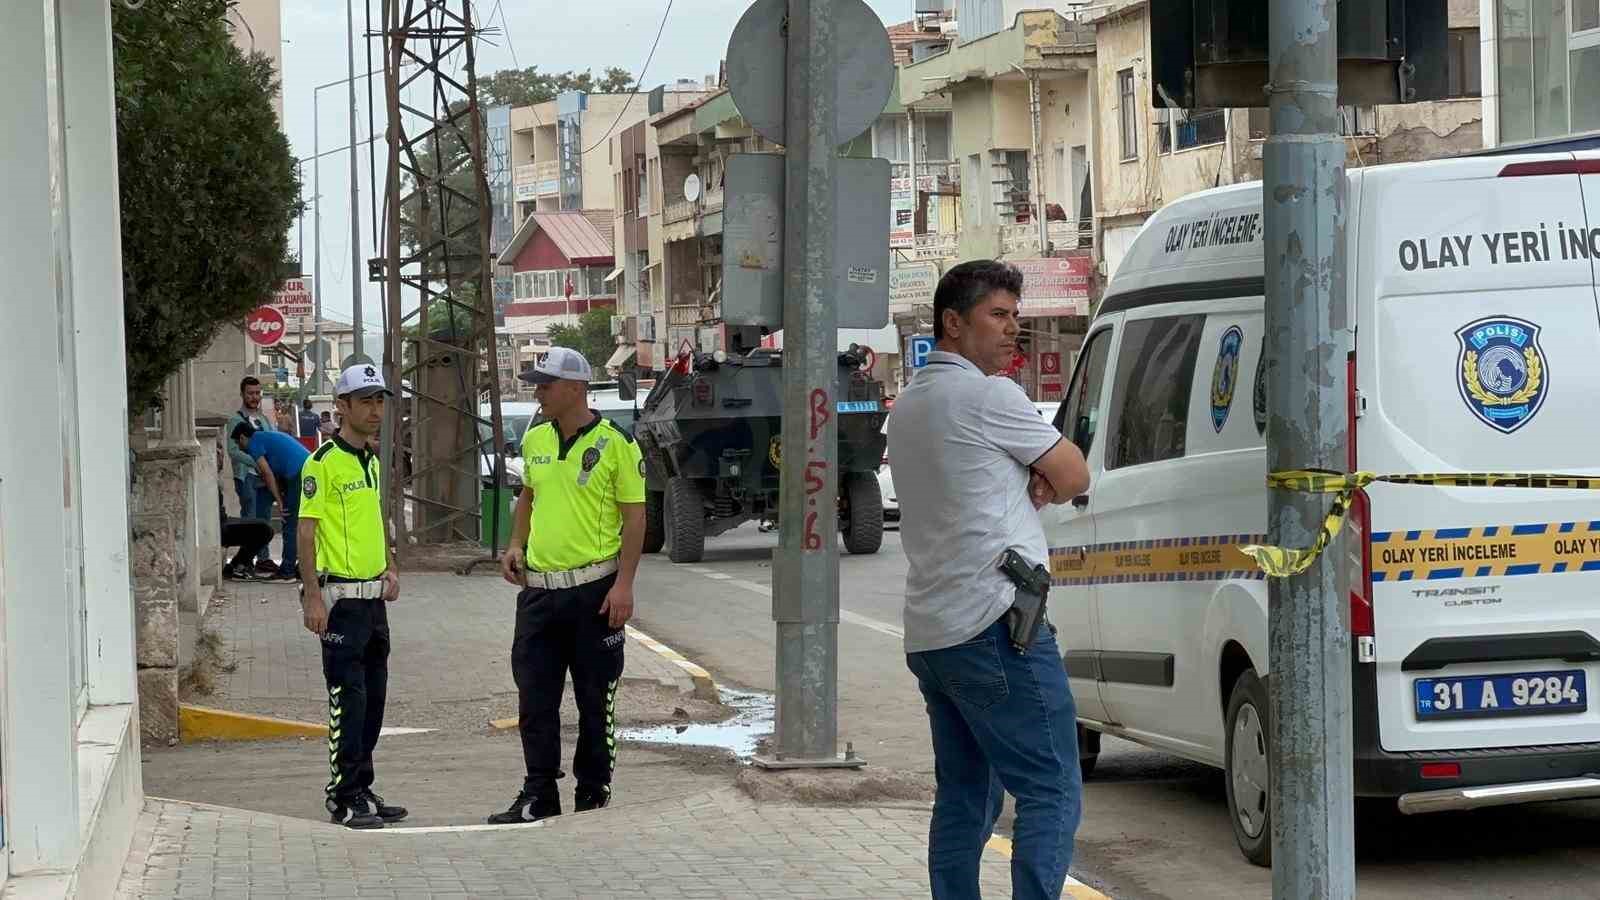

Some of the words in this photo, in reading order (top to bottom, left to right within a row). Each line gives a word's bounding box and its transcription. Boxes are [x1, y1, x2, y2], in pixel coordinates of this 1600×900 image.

[1165, 223, 1190, 253] OLAY
[1398, 234, 1473, 271] OLAY
[1482, 222, 1550, 264] YERİ
[250, 318, 281, 334] dyo
[914, 340, 931, 366] P
[1383, 548, 1415, 564] OLAY
[1419, 544, 1449, 562] YERİ
[1453, 541, 1517, 561] İNCELEME
[1554, 539, 1586, 555] OLAY
[1412, 585, 1501, 598] TRANSIT
[1444, 597, 1503, 607] CUSTOM
[1433, 682, 1464, 710] 31
[1480, 681, 1499, 709] A
[1512, 675, 1580, 706] 9284
